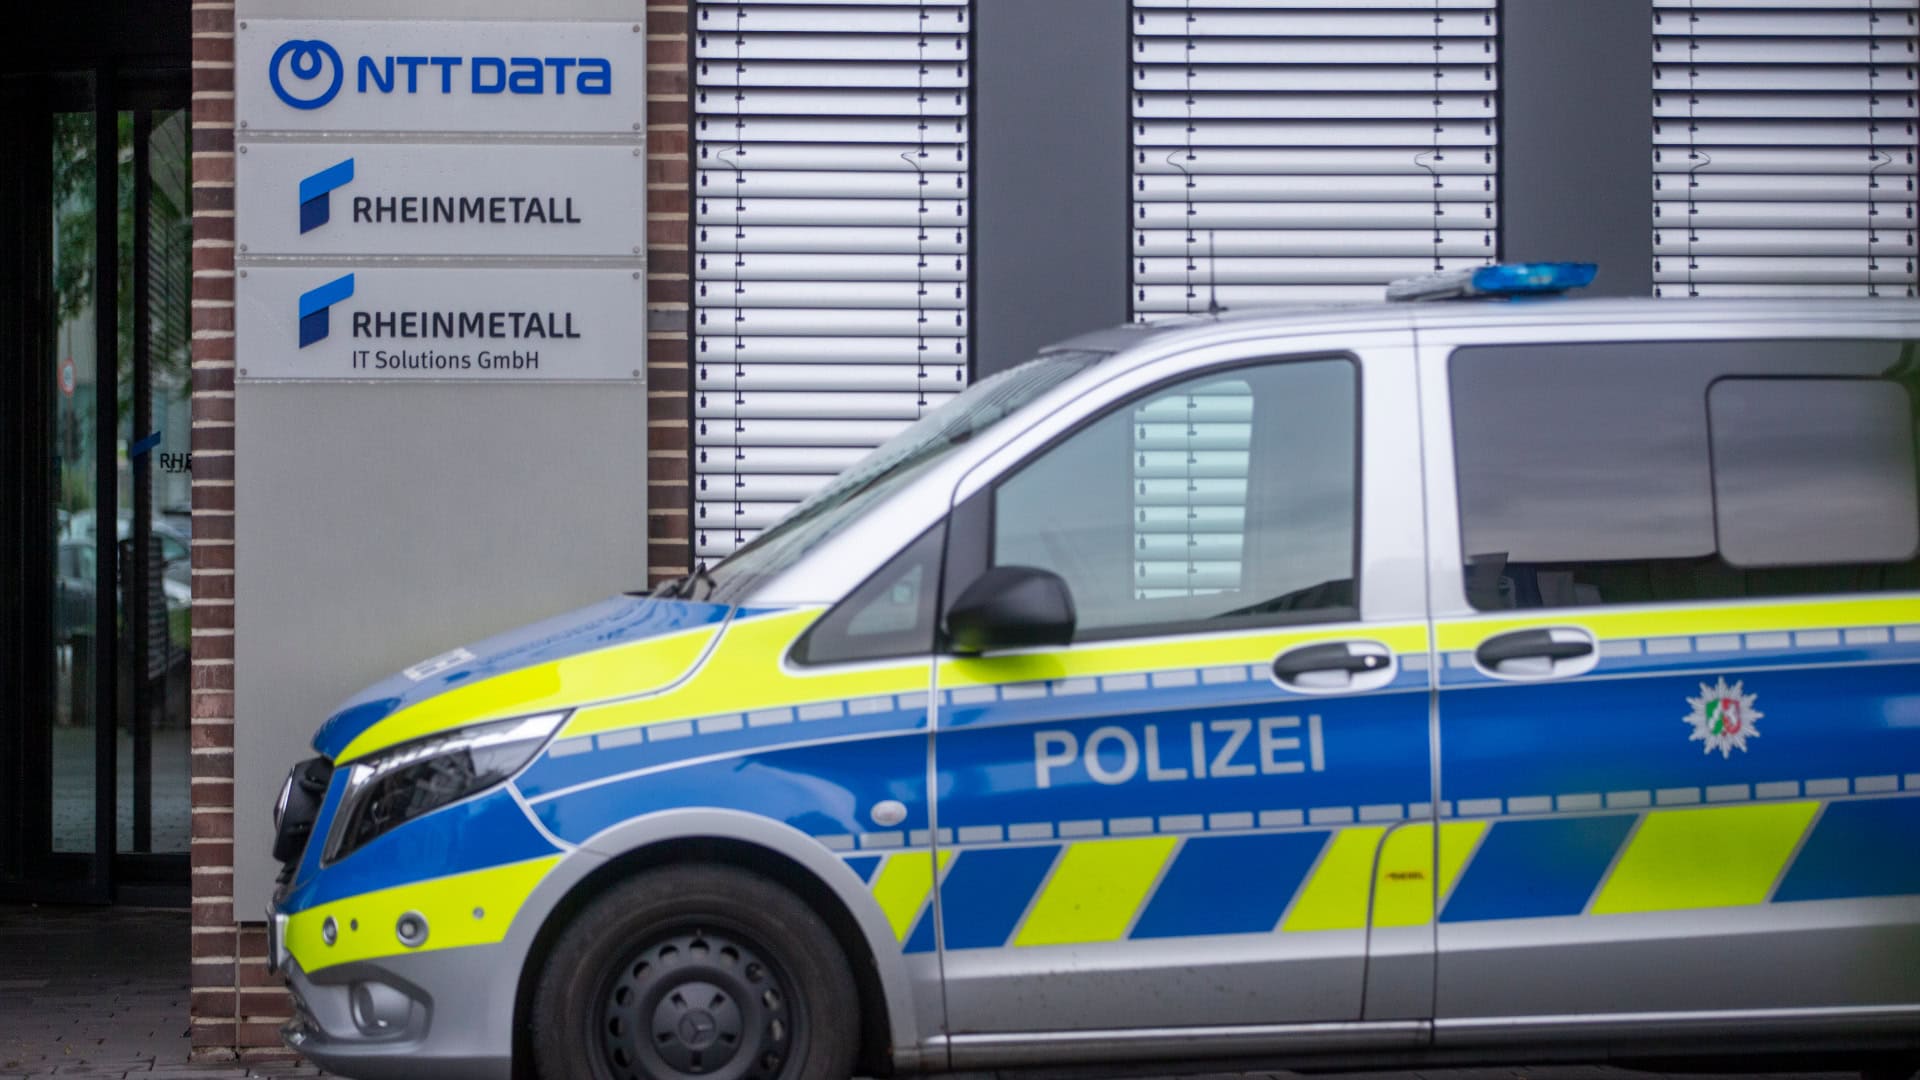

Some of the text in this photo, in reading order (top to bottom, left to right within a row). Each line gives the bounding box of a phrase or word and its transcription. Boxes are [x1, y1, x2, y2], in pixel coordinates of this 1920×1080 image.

[357, 56, 463, 94] NTT
[353, 196, 581, 224] RHEINMETALL
[352, 311, 581, 339] RHEINMETALL
[353, 350, 539, 369] IT Solutions GmbH
[1034, 714, 1326, 789] POLIZEI
